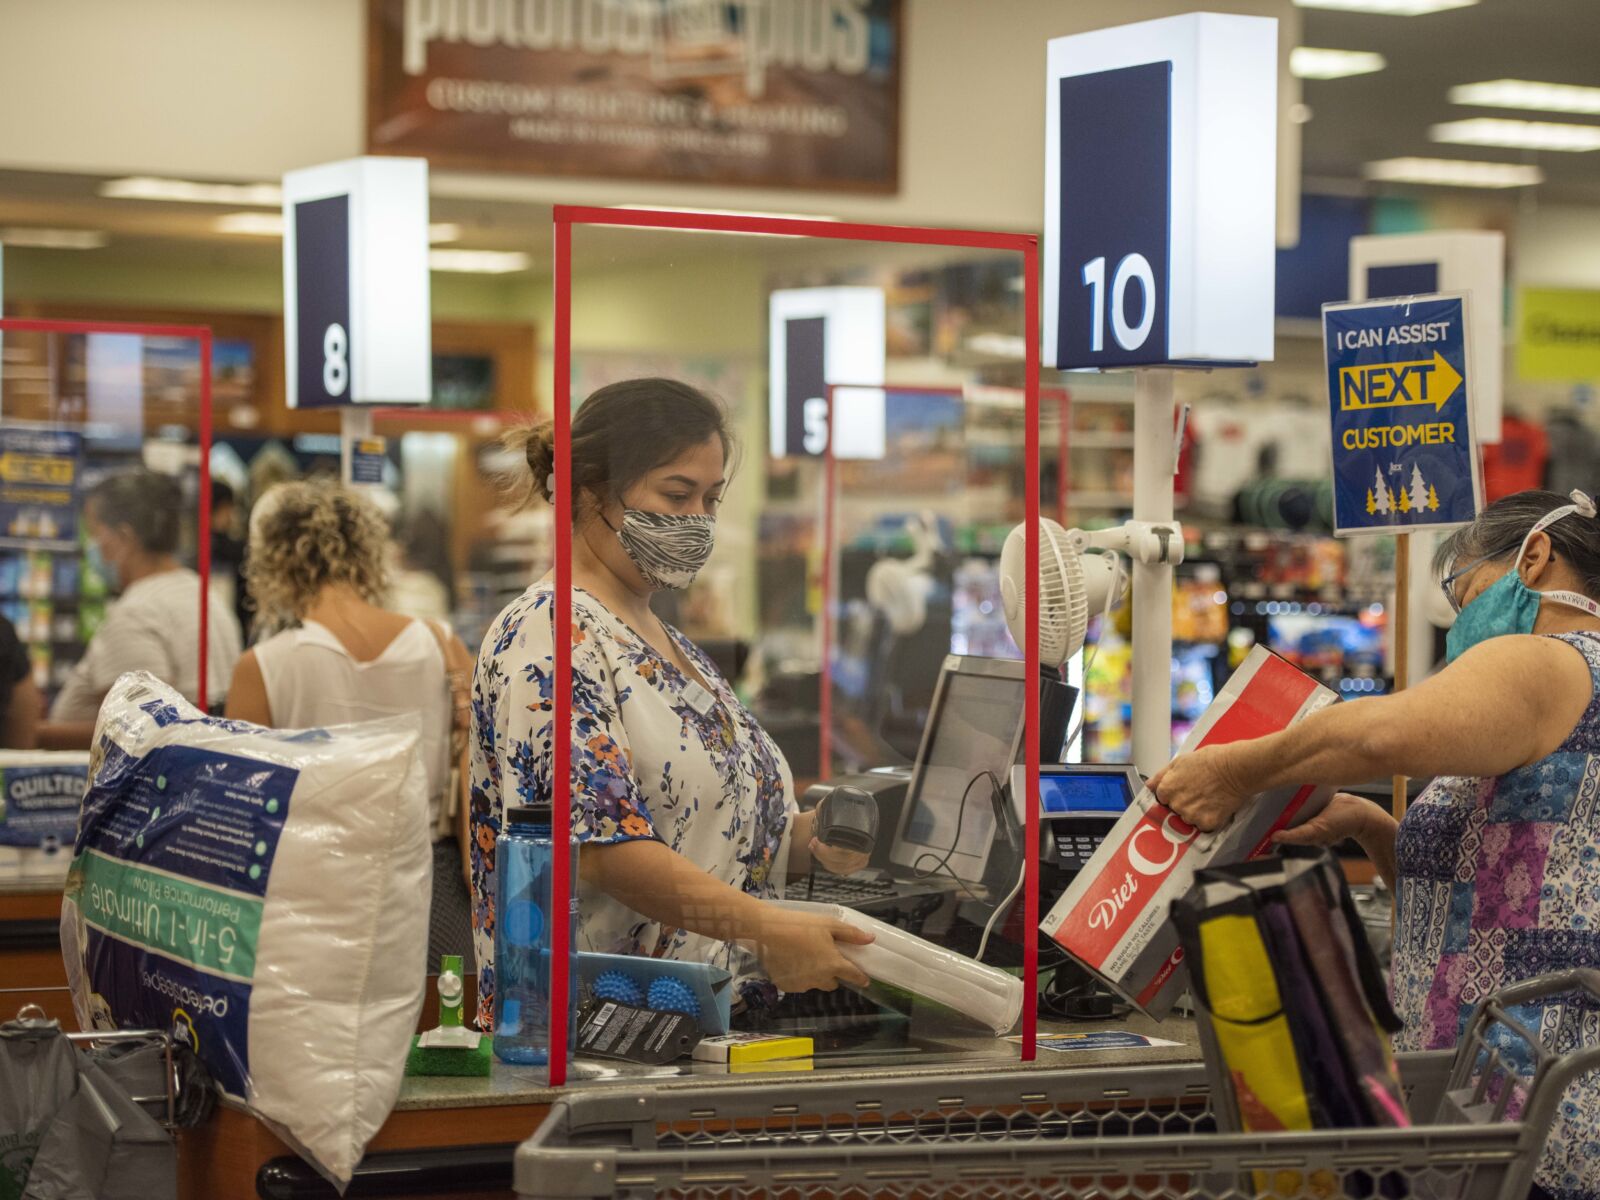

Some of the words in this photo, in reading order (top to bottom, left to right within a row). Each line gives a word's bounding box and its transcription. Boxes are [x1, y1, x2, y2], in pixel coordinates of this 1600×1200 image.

[1081, 252, 1156, 351] 10
[323, 322, 348, 397] 8
[1337, 331, 1343, 350] I
[1345, 327, 1383, 349] CAN
[1385, 322, 1450, 346] ASSIST
[1343, 363, 1436, 406] NEXT
[803, 397, 829, 455] 5
[1342, 422, 1455, 450] CUSTOMER
[133, 876, 161, 900] Pillow
[1088, 872, 1138, 930] Diet
[1128, 812, 1197, 875] Co
[91, 882, 160, 941] Ultimate
[163, 886, 240, 923] Performance
[1045, 913, 1058, 926] 12
[170, 910, 237, 964] 5-in-1
[1109, 960, 1118, 971] NO
[1116, 940, 1133, 961] SUGAR
[1130, 931, 1140, 942] NO
[1137, 904, 1161, 932] CALORIES
[1139, 920, 1155, 939] TASTE
